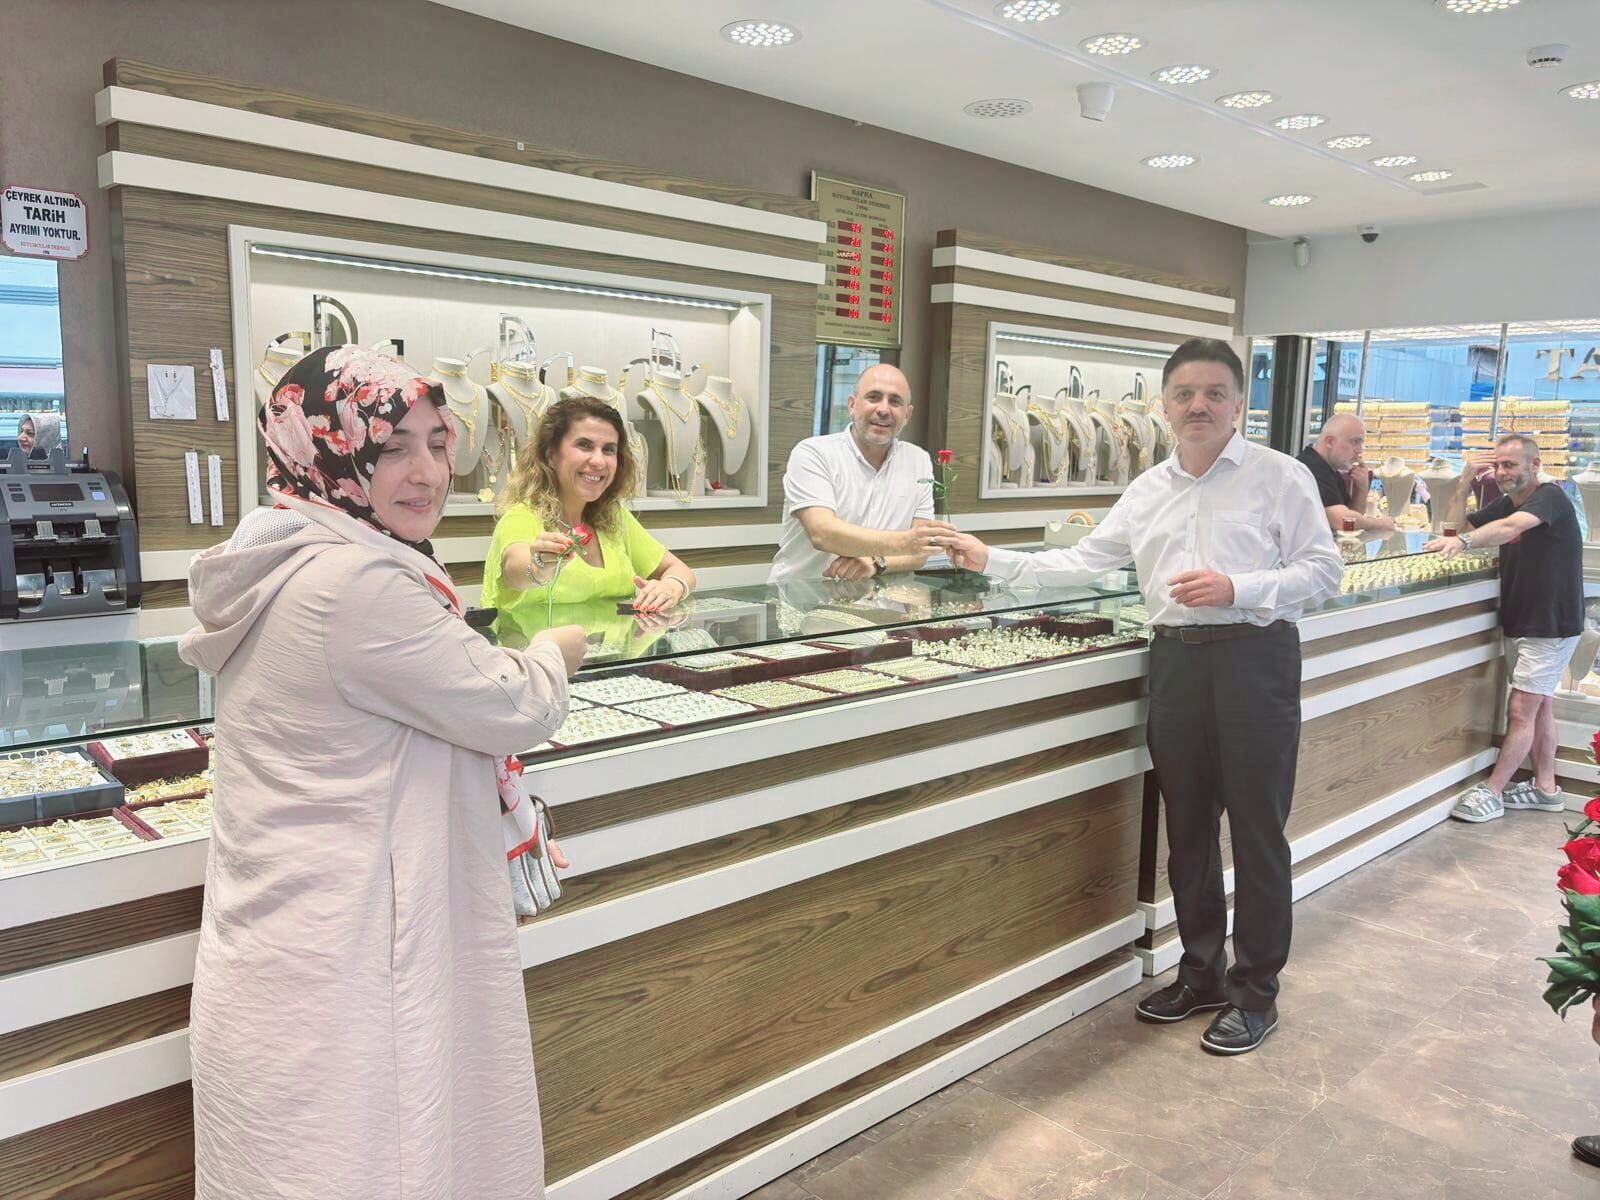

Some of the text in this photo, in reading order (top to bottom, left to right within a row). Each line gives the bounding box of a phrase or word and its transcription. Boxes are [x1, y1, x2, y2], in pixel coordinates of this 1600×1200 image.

[5, 190, 81, 208] ÇEYREK ALTINDA
[10, 223, 81, 240] AYRIMI YOKTUR.
